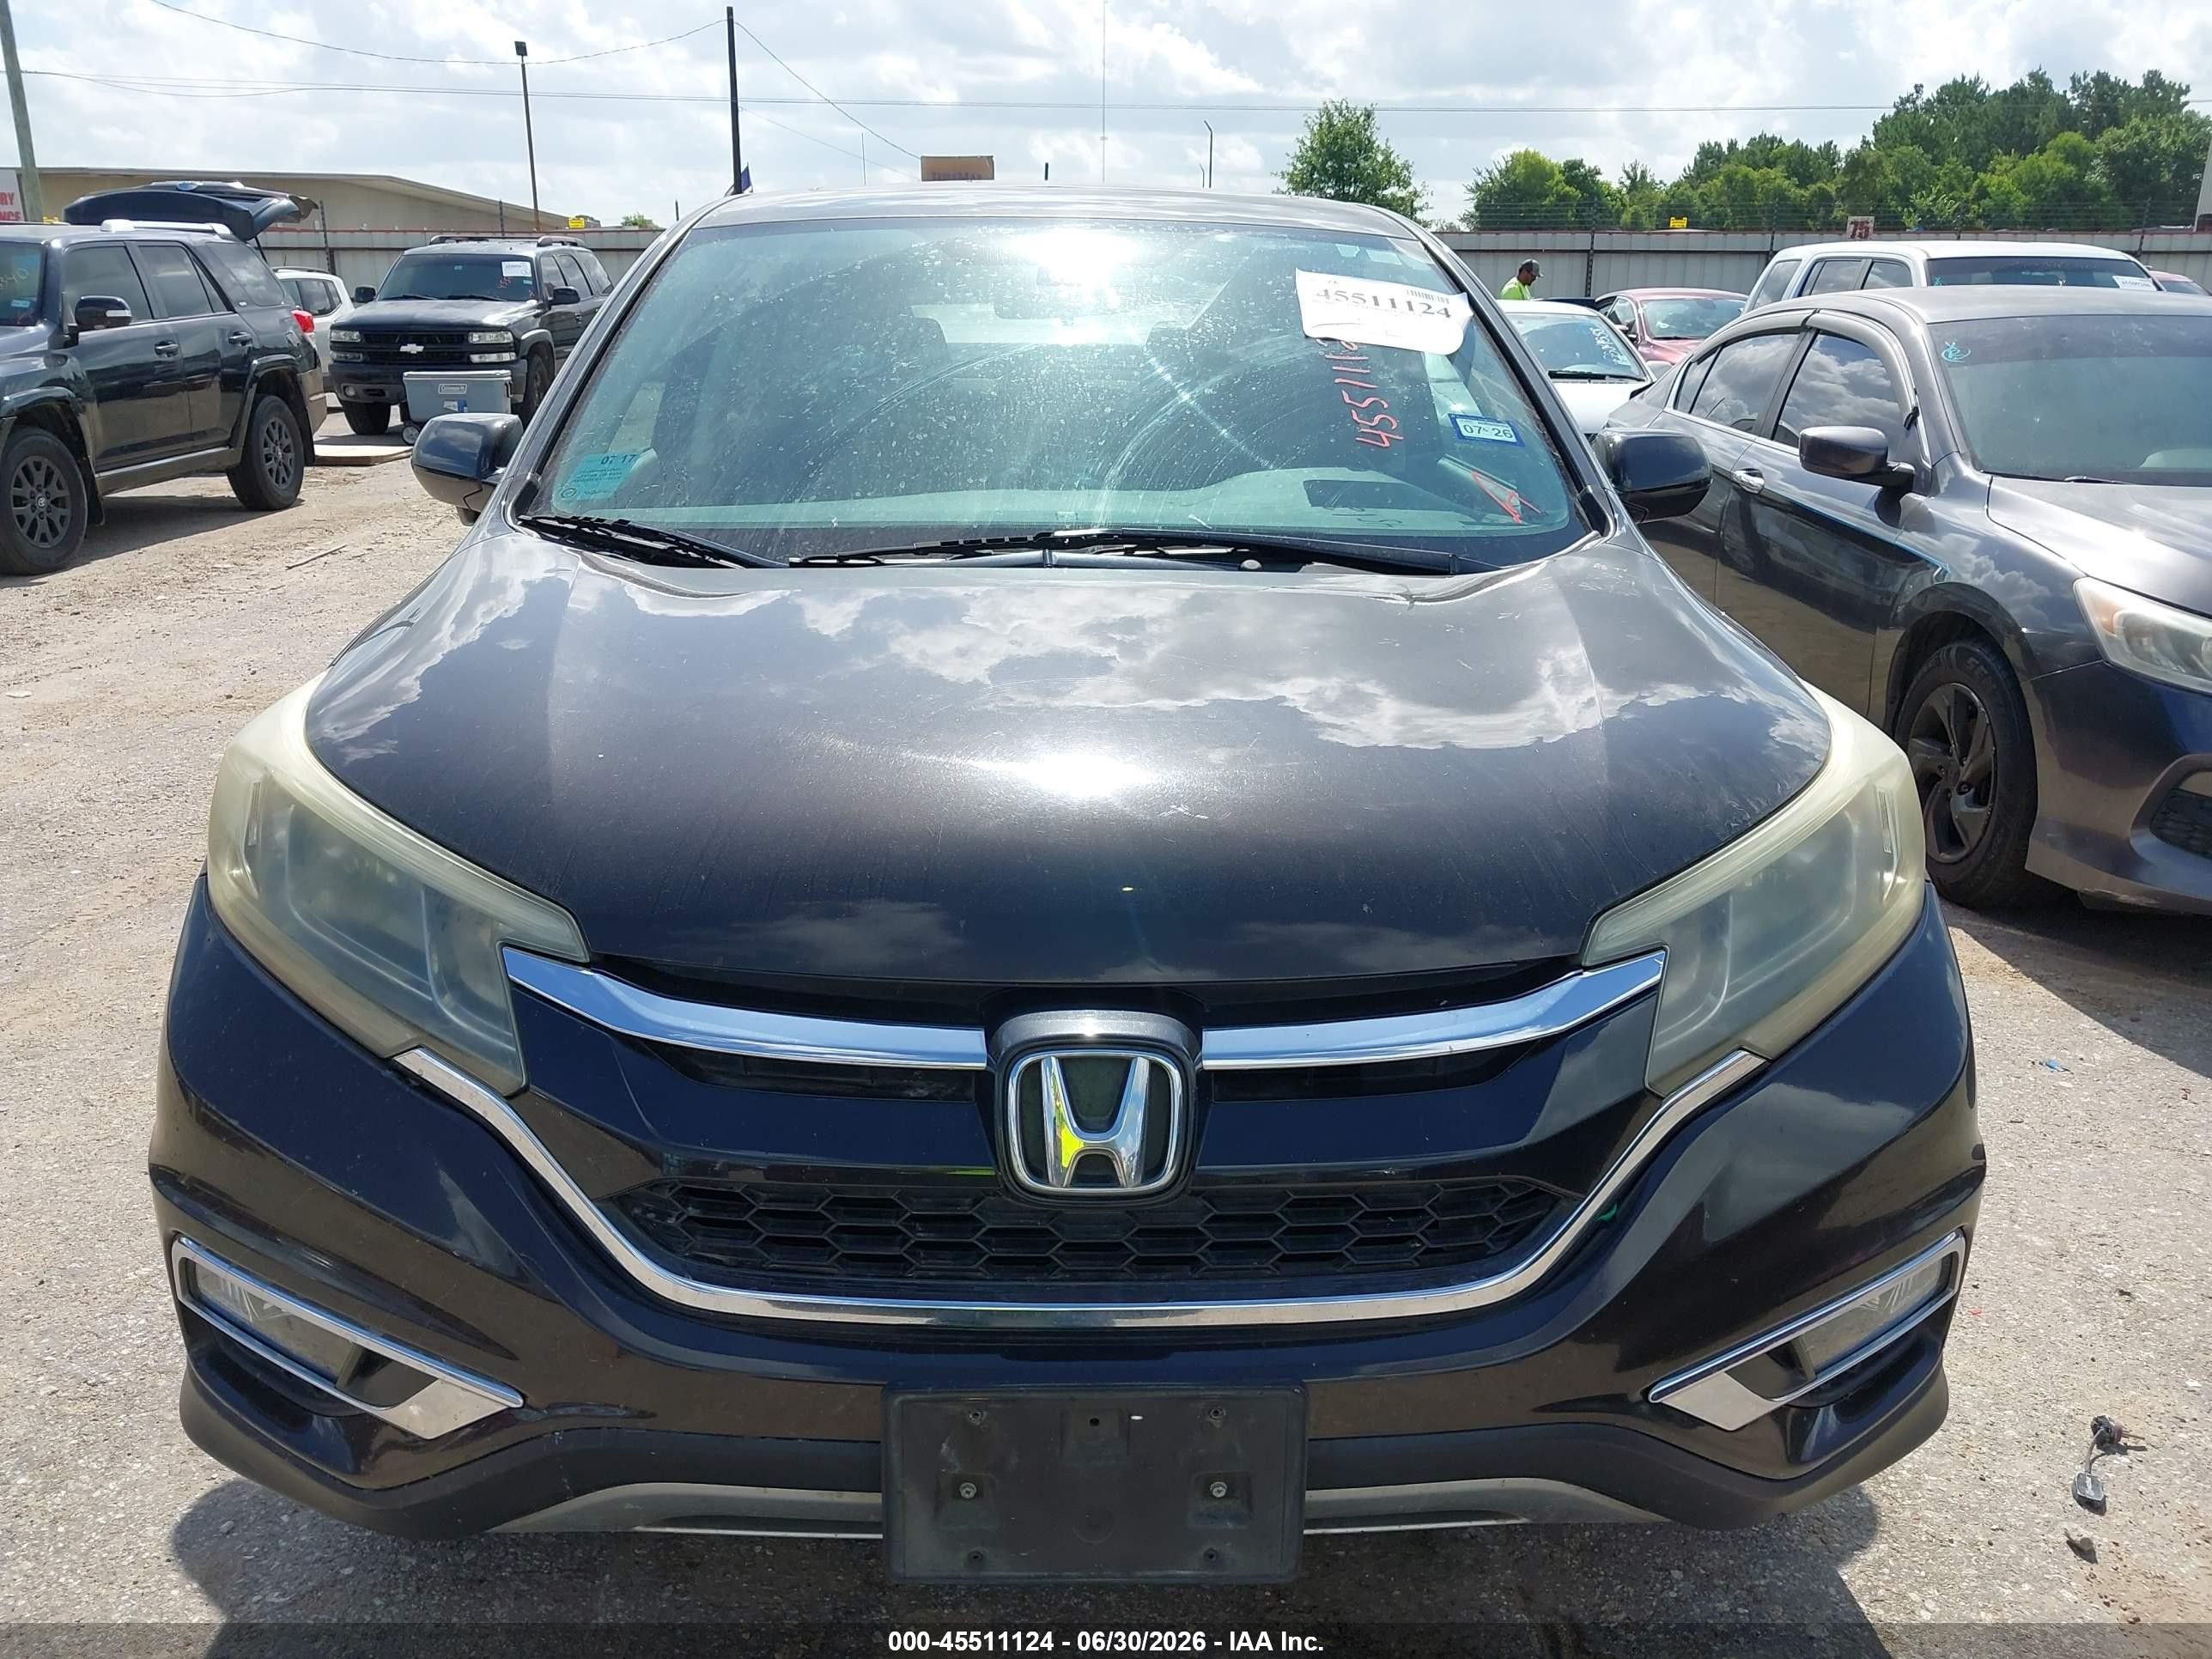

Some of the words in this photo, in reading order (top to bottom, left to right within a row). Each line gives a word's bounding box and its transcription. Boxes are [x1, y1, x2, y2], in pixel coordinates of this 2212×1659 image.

[1316, 288, 1451, 319] 45511124
[1462, 424, 1482, 434] 07
[1491, 428, 1513, 439] 26
